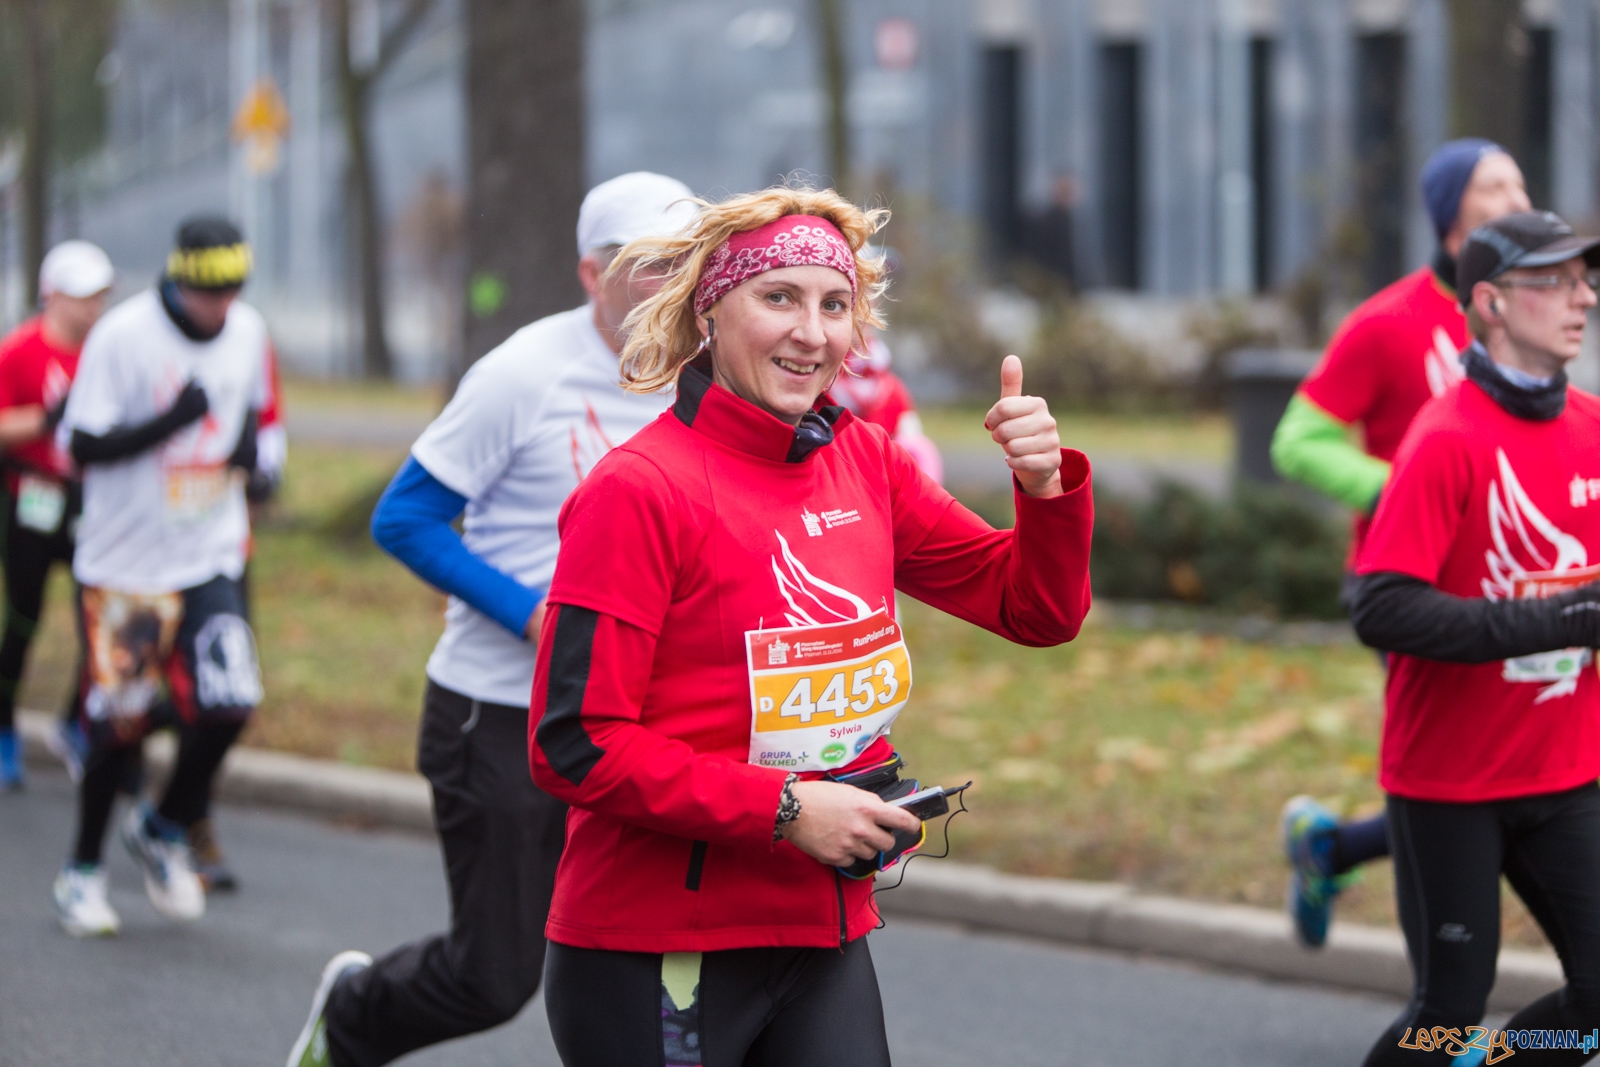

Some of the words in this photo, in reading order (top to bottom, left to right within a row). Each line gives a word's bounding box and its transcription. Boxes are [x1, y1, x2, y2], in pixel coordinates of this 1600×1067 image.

[853, 625, 895, 648] RunPoland.org
[793, 641, 804, 659] 1
[759, 696, 774, 713] D
[779, 659, 899, 723] 4453
[830, 723, 862, 739] Sylwia
[760, 751, 792, 759] GRUPA
[760, 758, 797, 767] LUXMED
